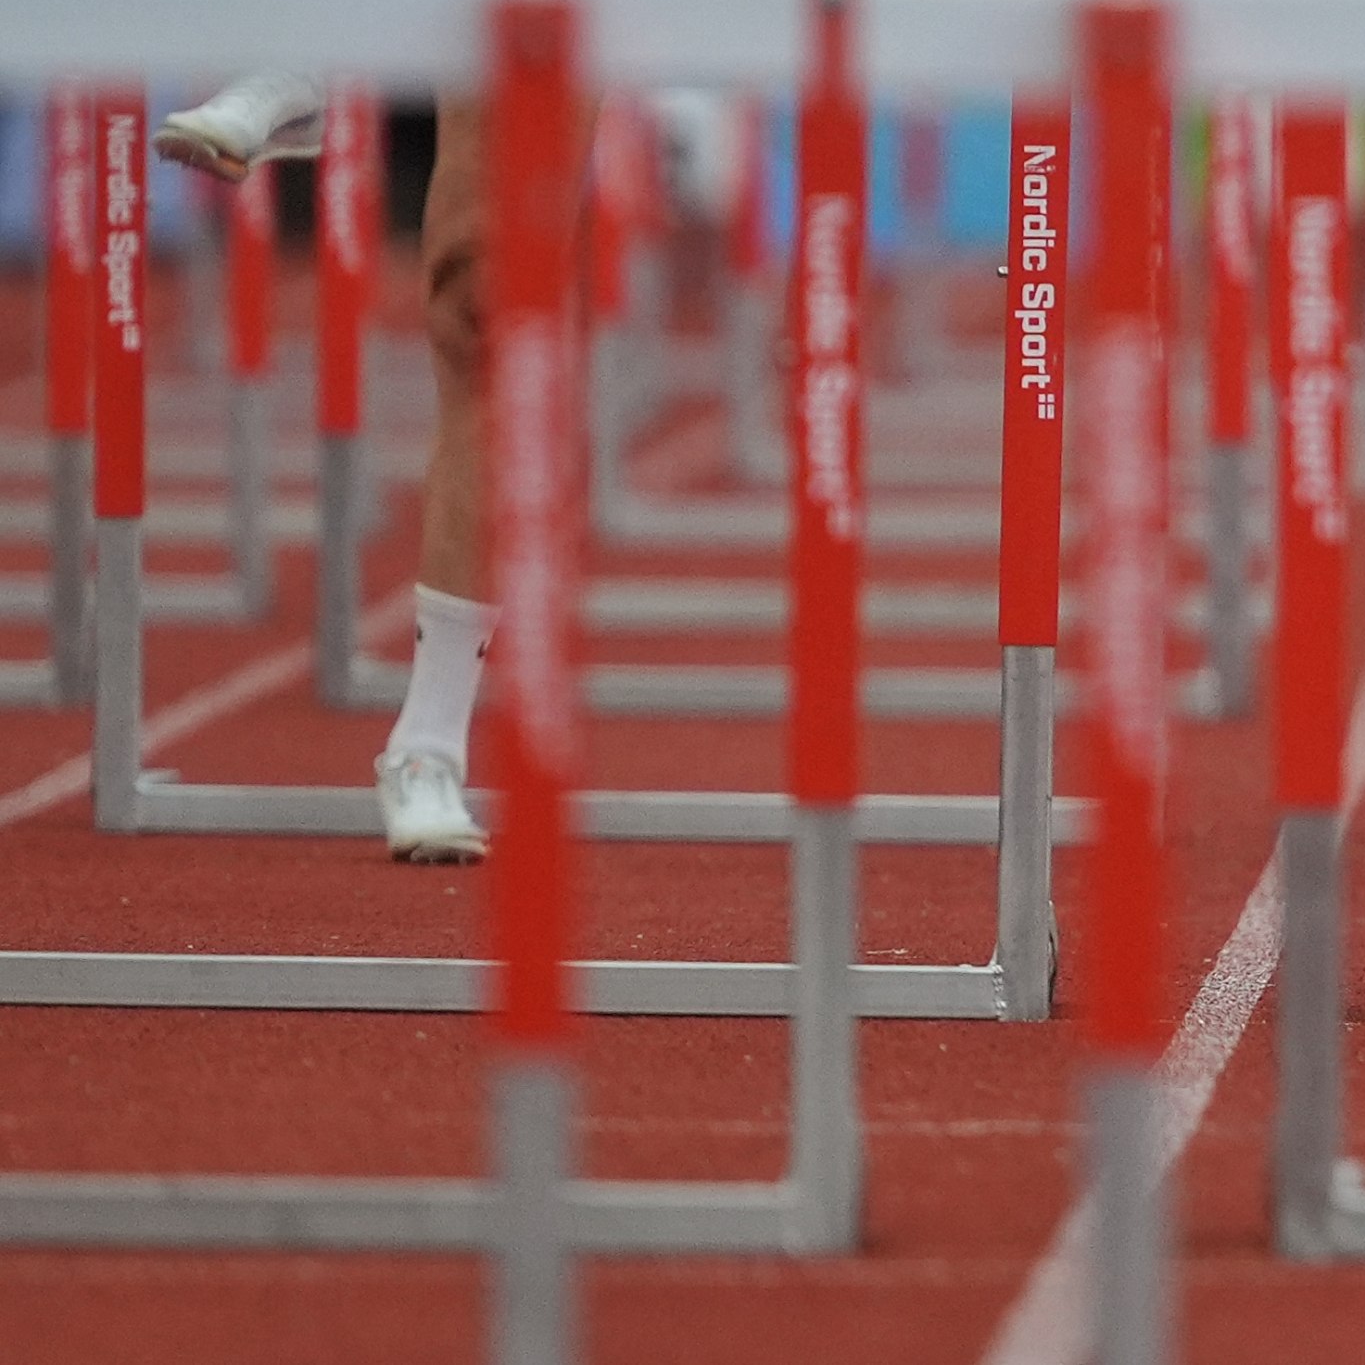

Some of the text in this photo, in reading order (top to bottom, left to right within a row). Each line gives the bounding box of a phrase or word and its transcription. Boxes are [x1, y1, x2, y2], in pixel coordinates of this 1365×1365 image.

[101, 114, 140, 325] Nordic Sport
[1014, 145, 1057, 390] Nordic Sport
